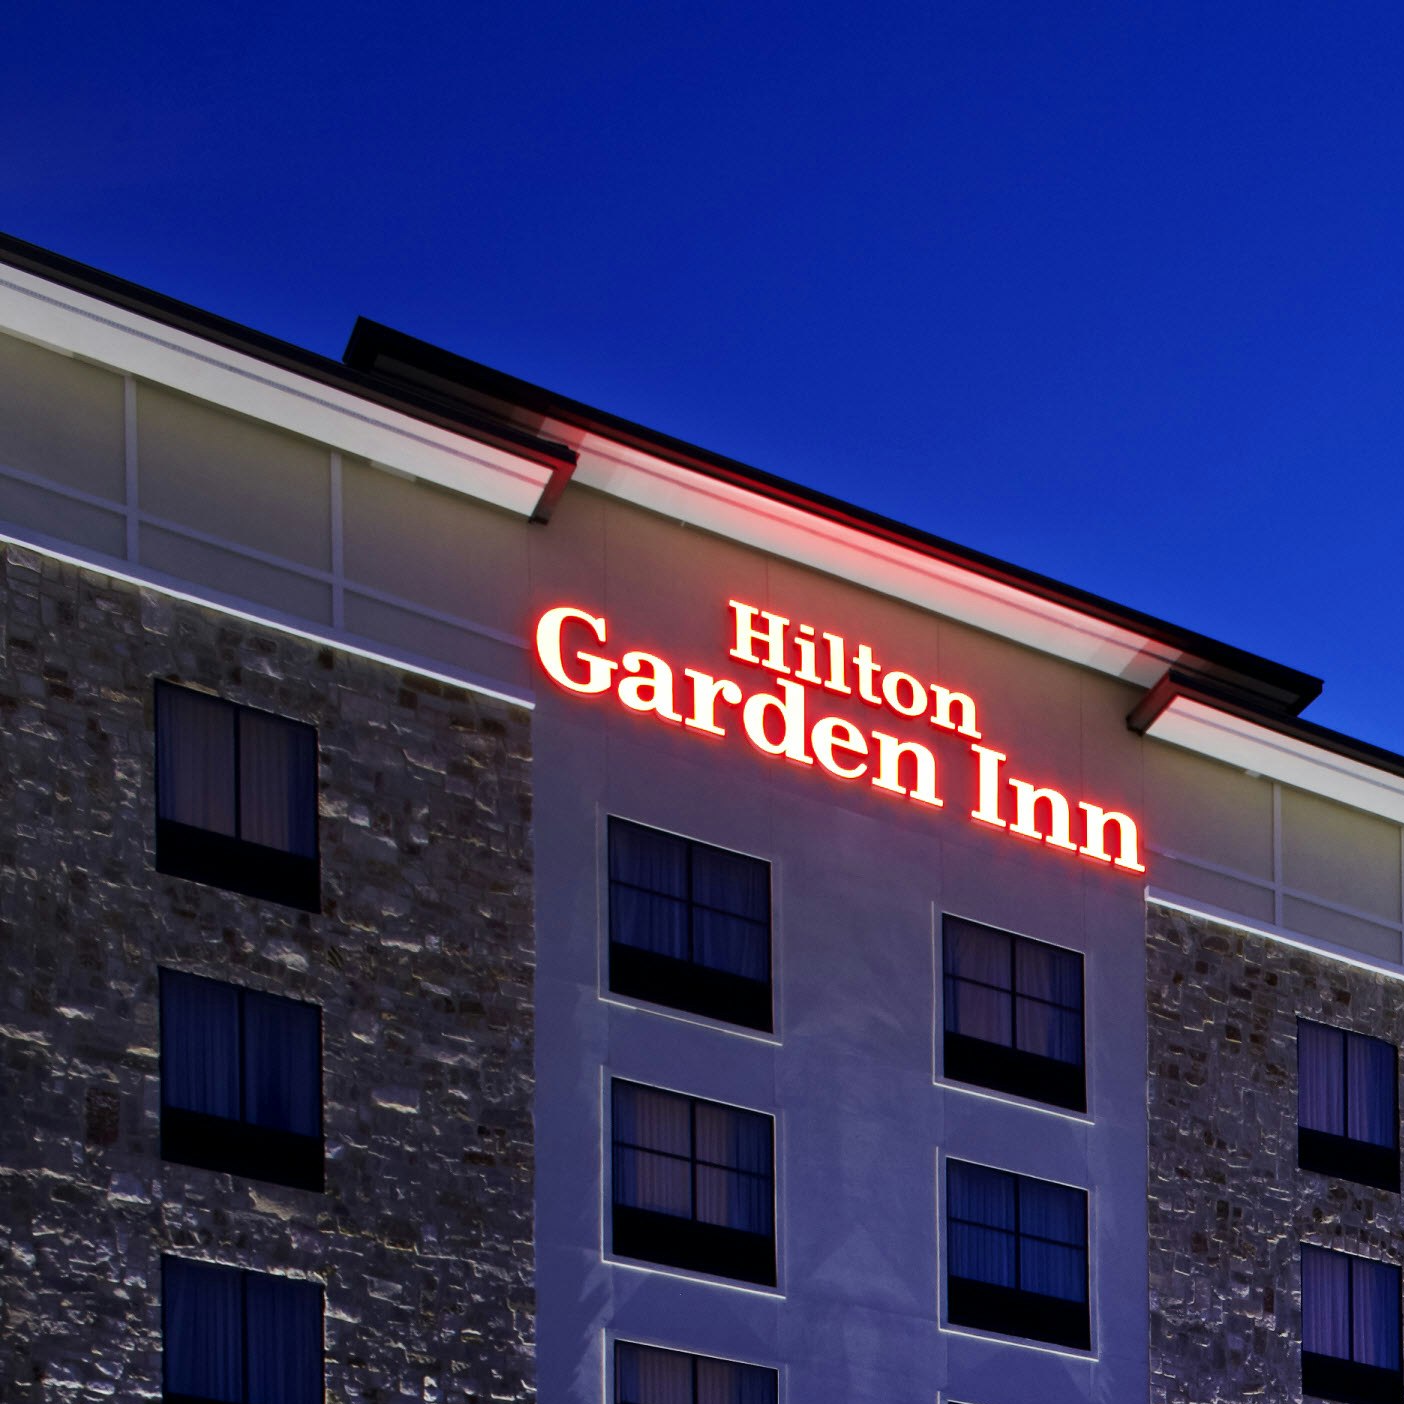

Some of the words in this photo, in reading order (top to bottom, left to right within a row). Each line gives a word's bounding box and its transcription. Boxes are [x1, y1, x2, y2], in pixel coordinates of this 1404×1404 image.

[535, 606, 944, 808] Garden
[971, 743, 1146, 873] Inn
[729, 600, 982, 741] Hilton
